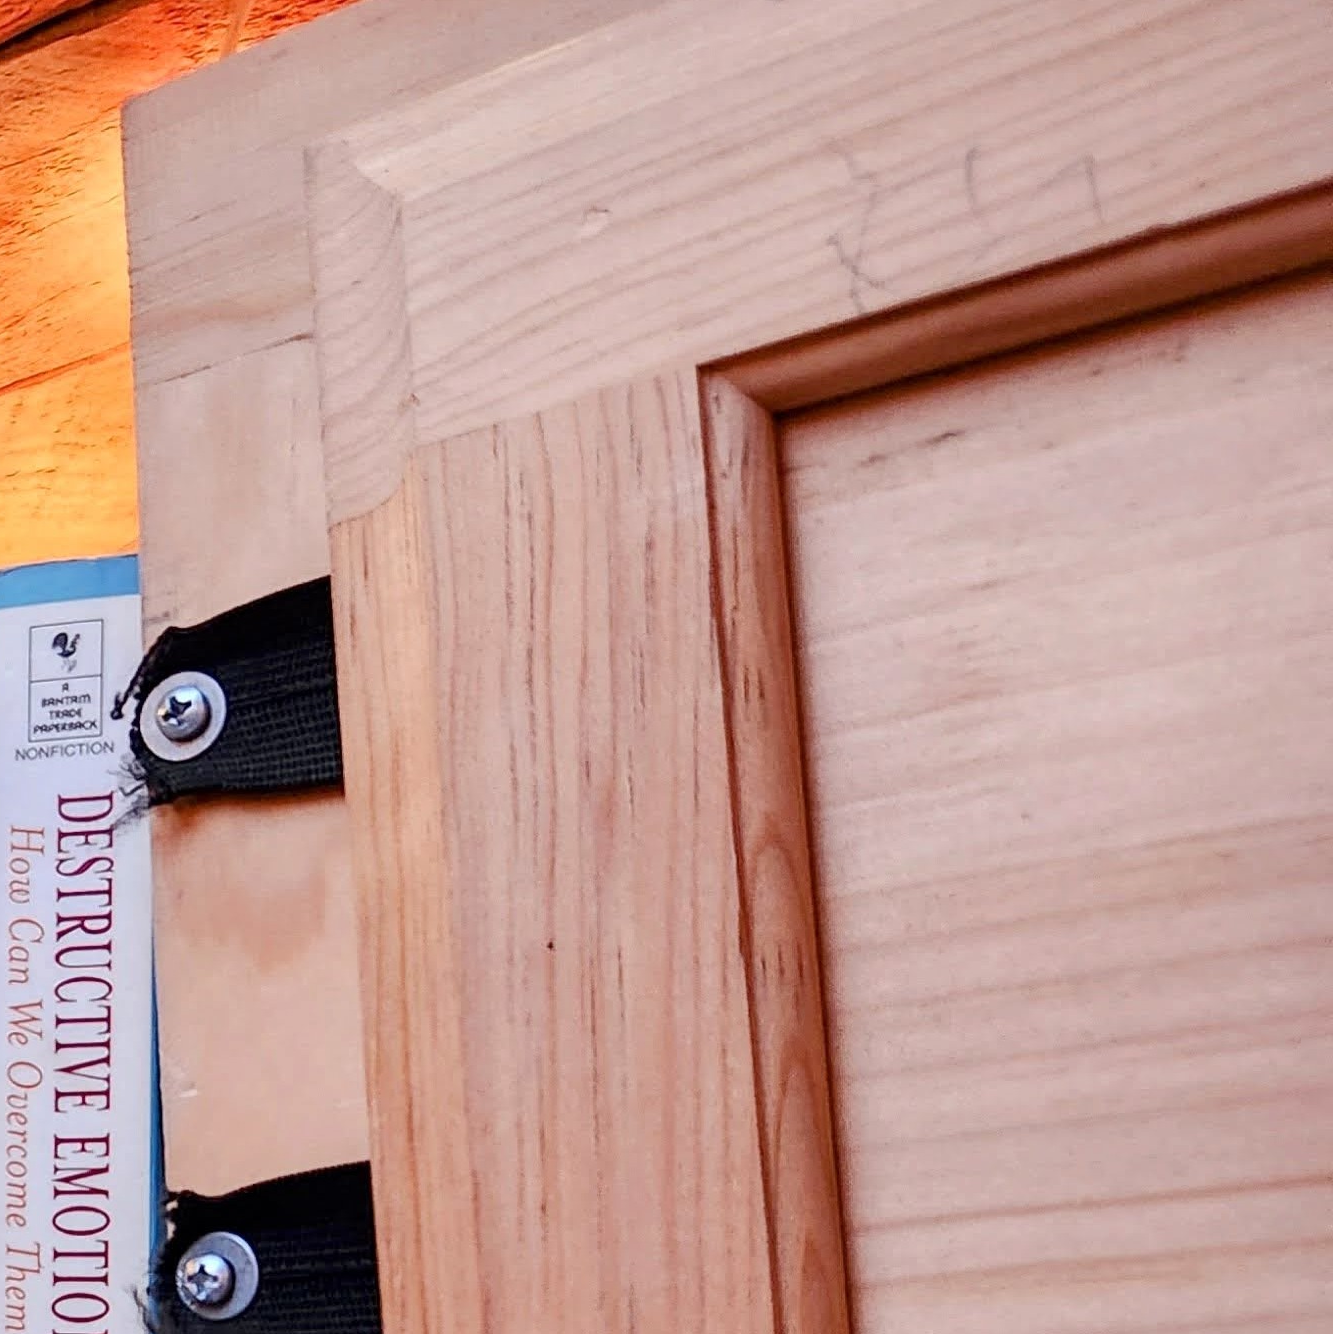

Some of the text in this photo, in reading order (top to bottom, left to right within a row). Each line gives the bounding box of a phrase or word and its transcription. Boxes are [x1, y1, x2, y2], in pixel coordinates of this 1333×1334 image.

[41, 693, 91, 708] BANTAM
[48, 708, 82, 720] TRADE
[14, 741, 115, 761] NONFICTION
[33, 720, 98, 735] PAPERBACK
[8, 825, 45, 905] How
[7, 918, 45, 986] Can
[52, 790, 115, 1114] DESTRUCTIVE
[6, 999, 44, 1046] We
[5, 1060, 43, 1229] Overcome
